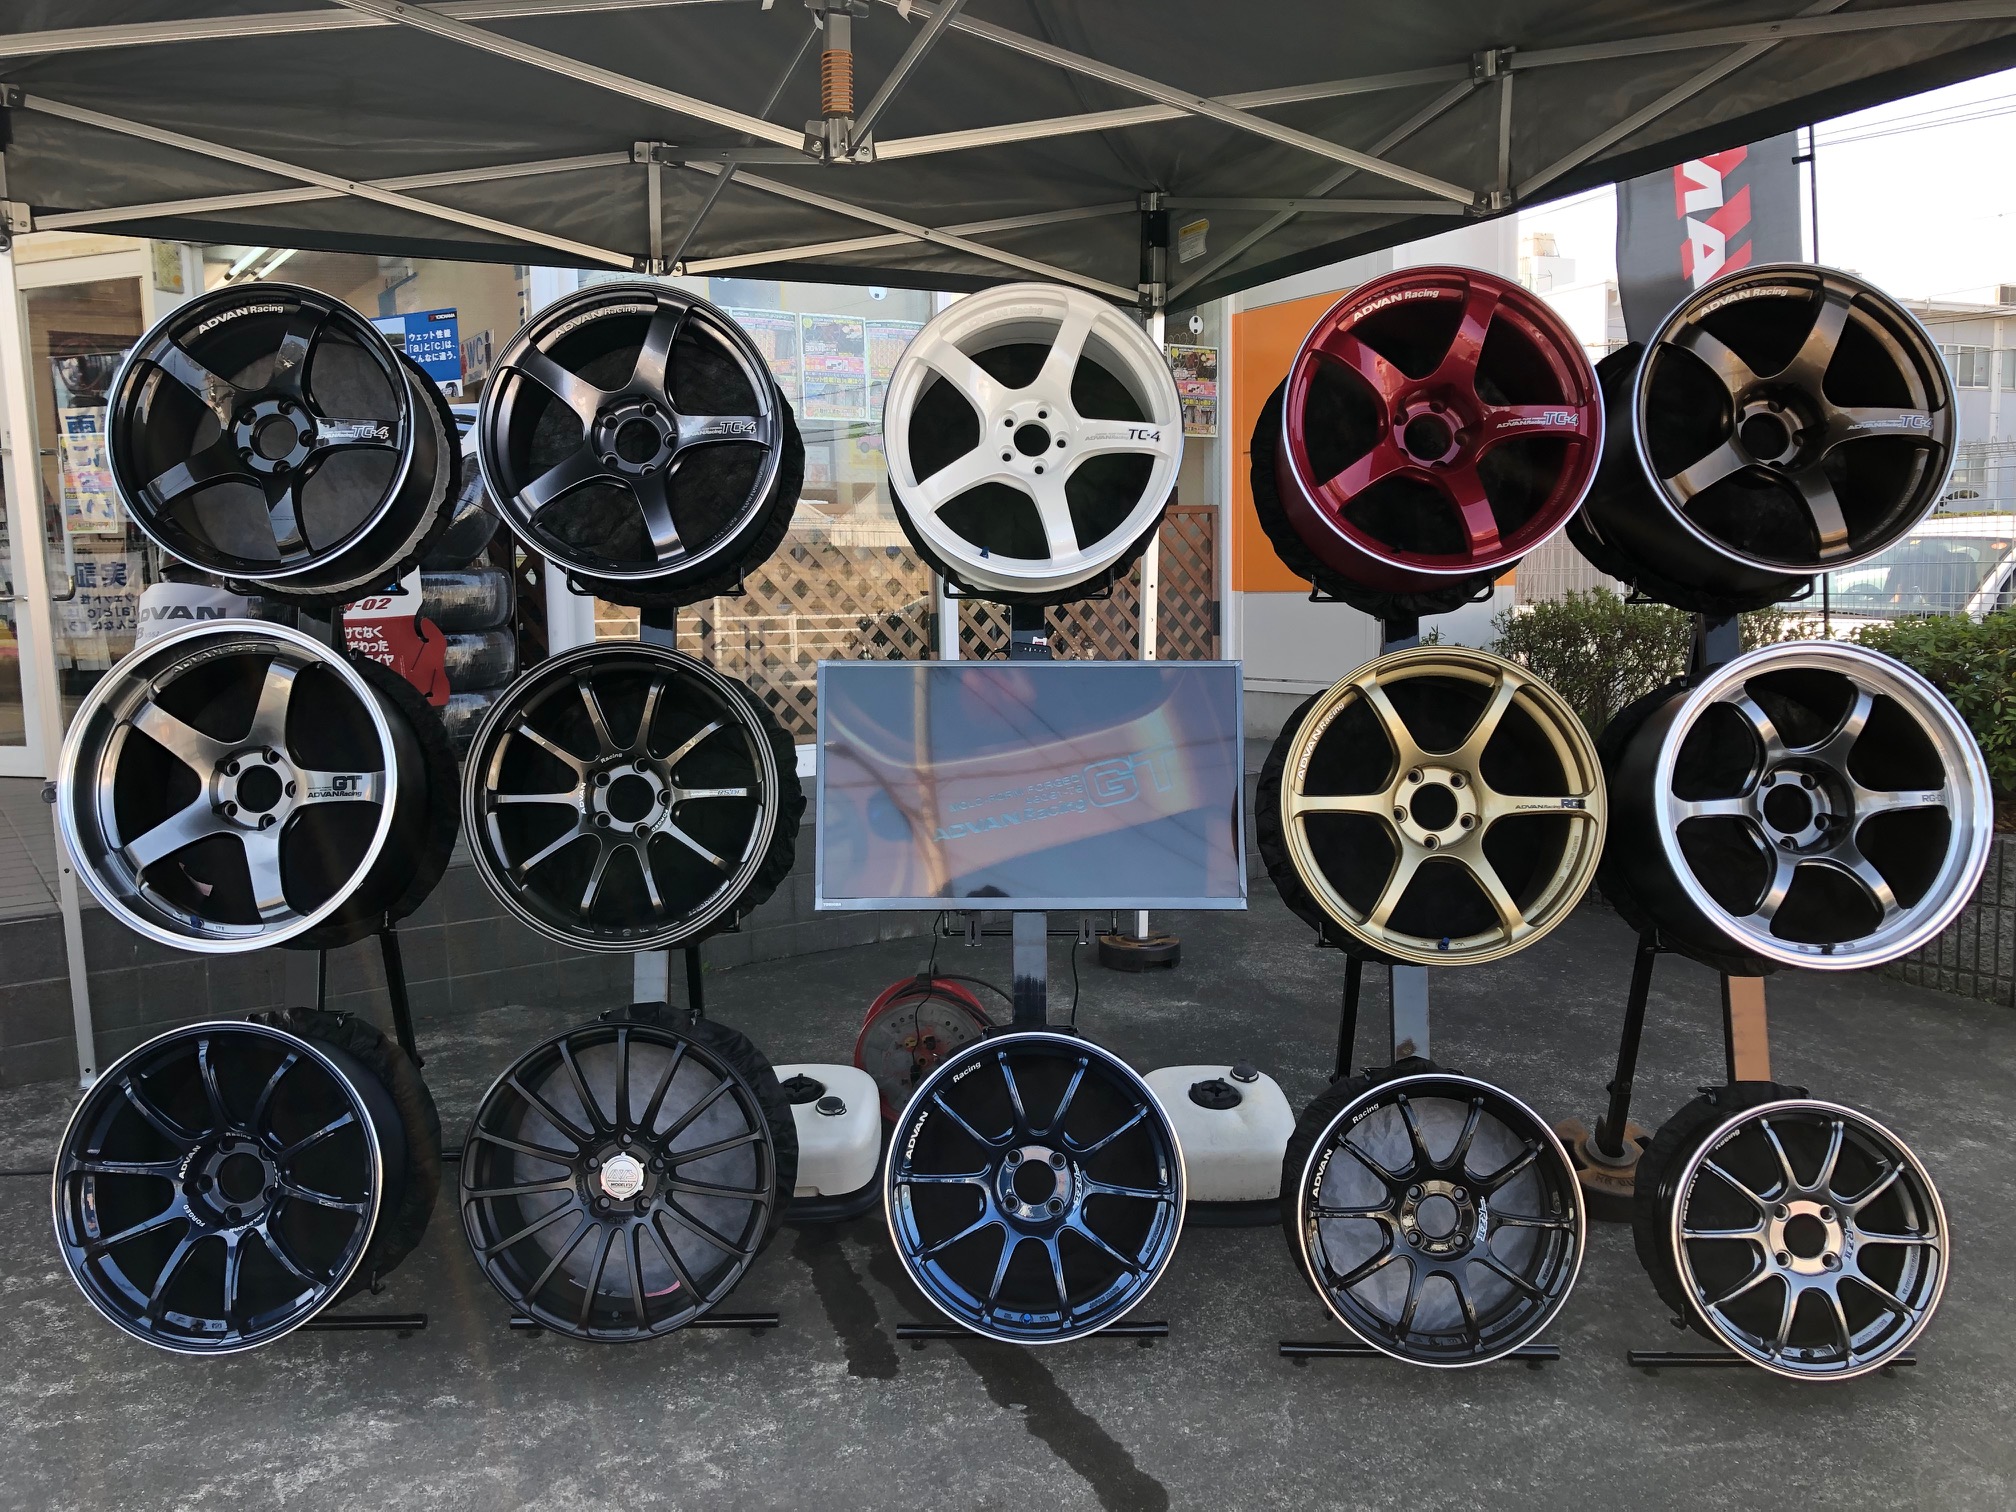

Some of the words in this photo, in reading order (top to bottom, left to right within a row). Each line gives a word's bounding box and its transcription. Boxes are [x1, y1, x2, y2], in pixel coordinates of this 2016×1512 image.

[1353, 293, 1402, 322] ADVAN
[1405, 288, 1440, 299] Racing
[1700, 290, 1750, 317] ADVAN
[1752, 287, 1788, 297] Racing
[199, 307, 248, 335] ADVAN
[250, 304, 284, 314] Racing
[554, 310, 602, 338] ADVAN
[604, 305, 638, 316] Racing
[408, 328, 451, 342] ウェット性能
[466, 336, 484, 369] WC
[351, 424, 390, 440] TC-4
[719, 420, 757, 435] TC-4
[1543, 411, 1579, 427] TC-4
[1900, 414, 1933, 431] TC-4
[1128, 428, 1161, 443] TC-4
[347, 639, 389, 652] だわった
[1298, 728, 1322, 781] ADVAN
[1319, 702, 1345, 731] Racing
[332, 775, 362, 791] GT
[579, 782, 587, 814] ADVAN
[600, 753, 623, 764] Racing
[1027, 773, 1080, 795] FORGED
[1082, 739, 1176, 808] GT
[934, 812, 1021, 842] ADVAN
[1023, 799, 1088, 823] Racing
[904, 1111, 929, 1160] ADVAN
[952, 1061, 982, 1083] Racing
[178, 1145, 201, 1179] ADVAN
[1312, 1148, 1333, 1198] ADVAN
[1352, 1102, 1380, 1124] Racing
[182, 1204, 206, 1228] FORGED
